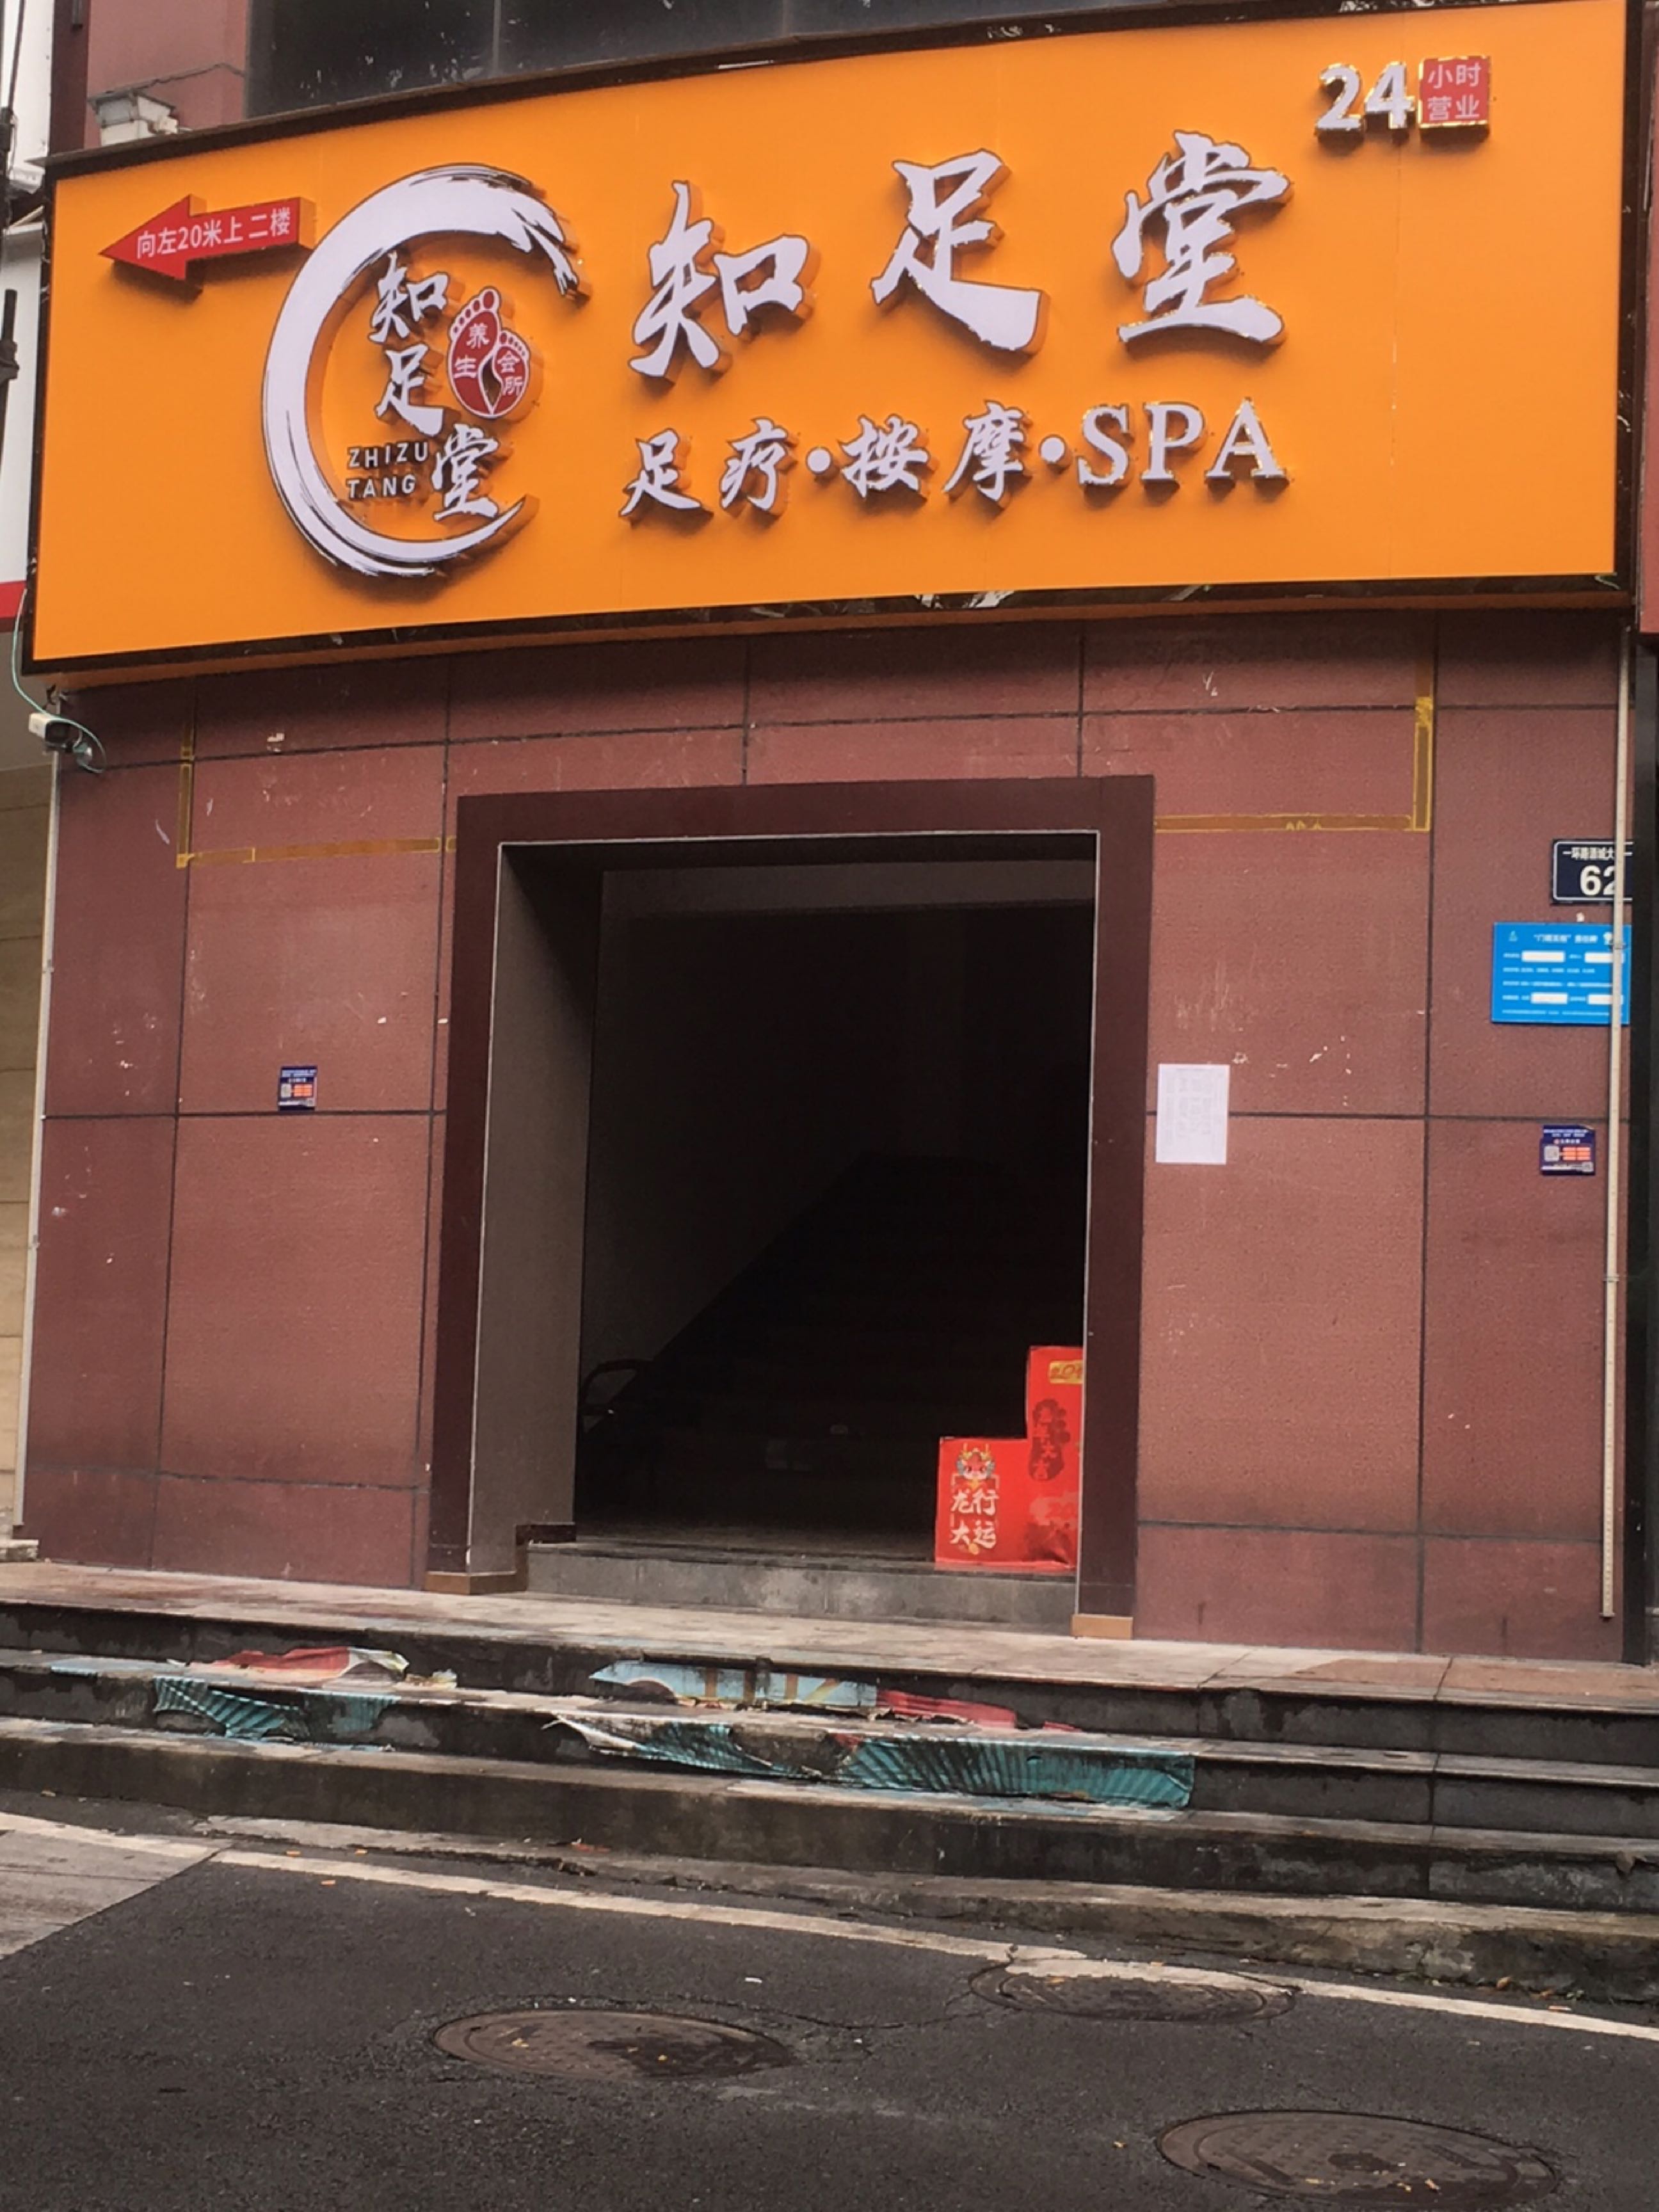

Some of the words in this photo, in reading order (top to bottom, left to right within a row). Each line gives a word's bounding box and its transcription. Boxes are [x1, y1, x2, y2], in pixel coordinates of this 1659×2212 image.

[1427, 63, 1481, 88] 小时
[1315, 62, 1415, 131] 24
[1427, 95, 1480, 121] 营业
[136, 207, 291, 259] 向左20米上二楼
[629, 131, 1290, 379] 知足堂
[454, 323, 490, 380] 养生
[369, 252, 499, 521] 知足堂
[497, 353, 524, 397] 会所
[348, 442, 429, 469] ZHIZU
[347, 474, 417, 499] TANG
[950, 1488, 999, 1516] 龙行
[950, 1521, 997, 1549] 大运
